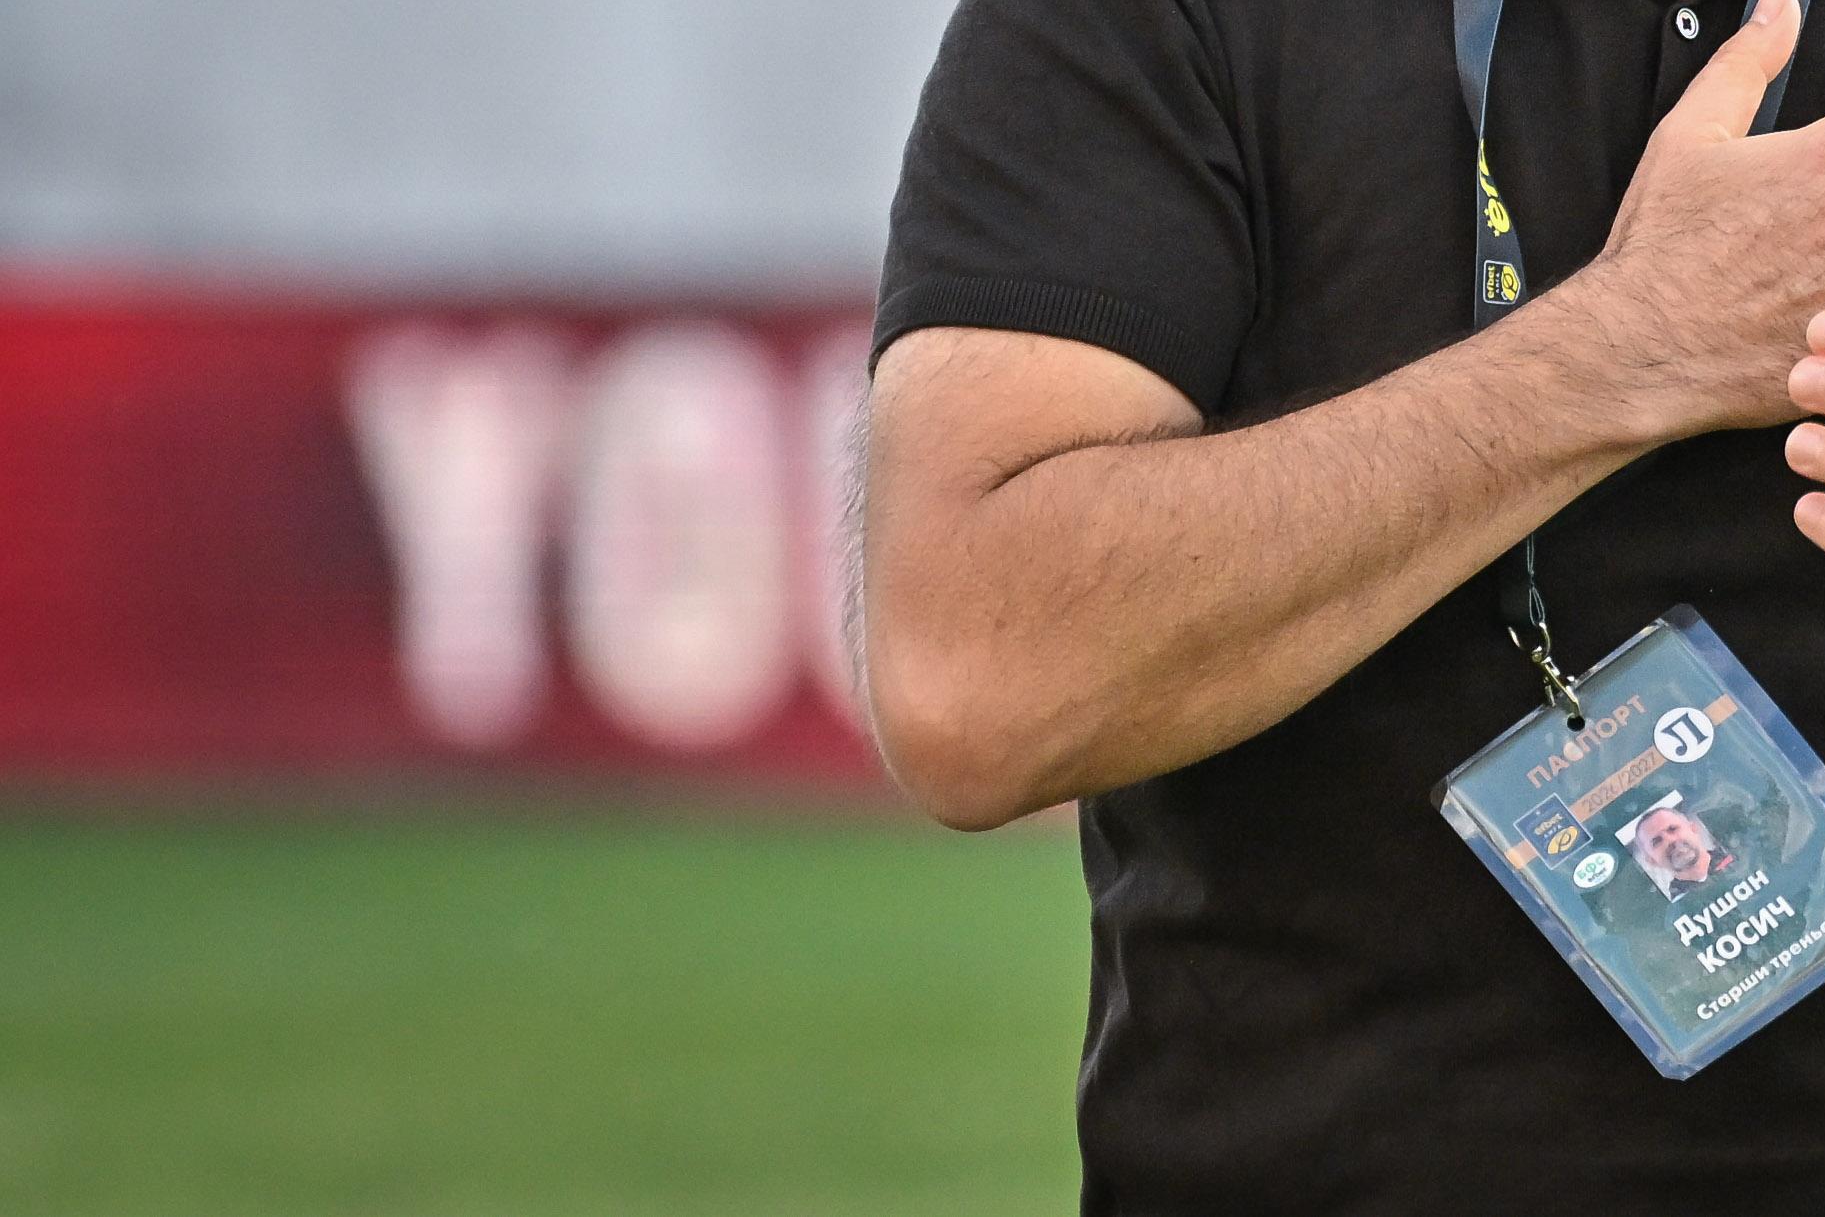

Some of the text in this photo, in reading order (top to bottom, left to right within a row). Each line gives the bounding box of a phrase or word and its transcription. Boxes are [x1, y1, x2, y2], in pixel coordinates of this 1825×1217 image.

[1486, 265, 1496, 299] efbet
[1673, 869, 1770, 947] Душан
[1696, 895, 1796, 975] КОСИЧ
[1696, 965, 1770, 1020] Старши
